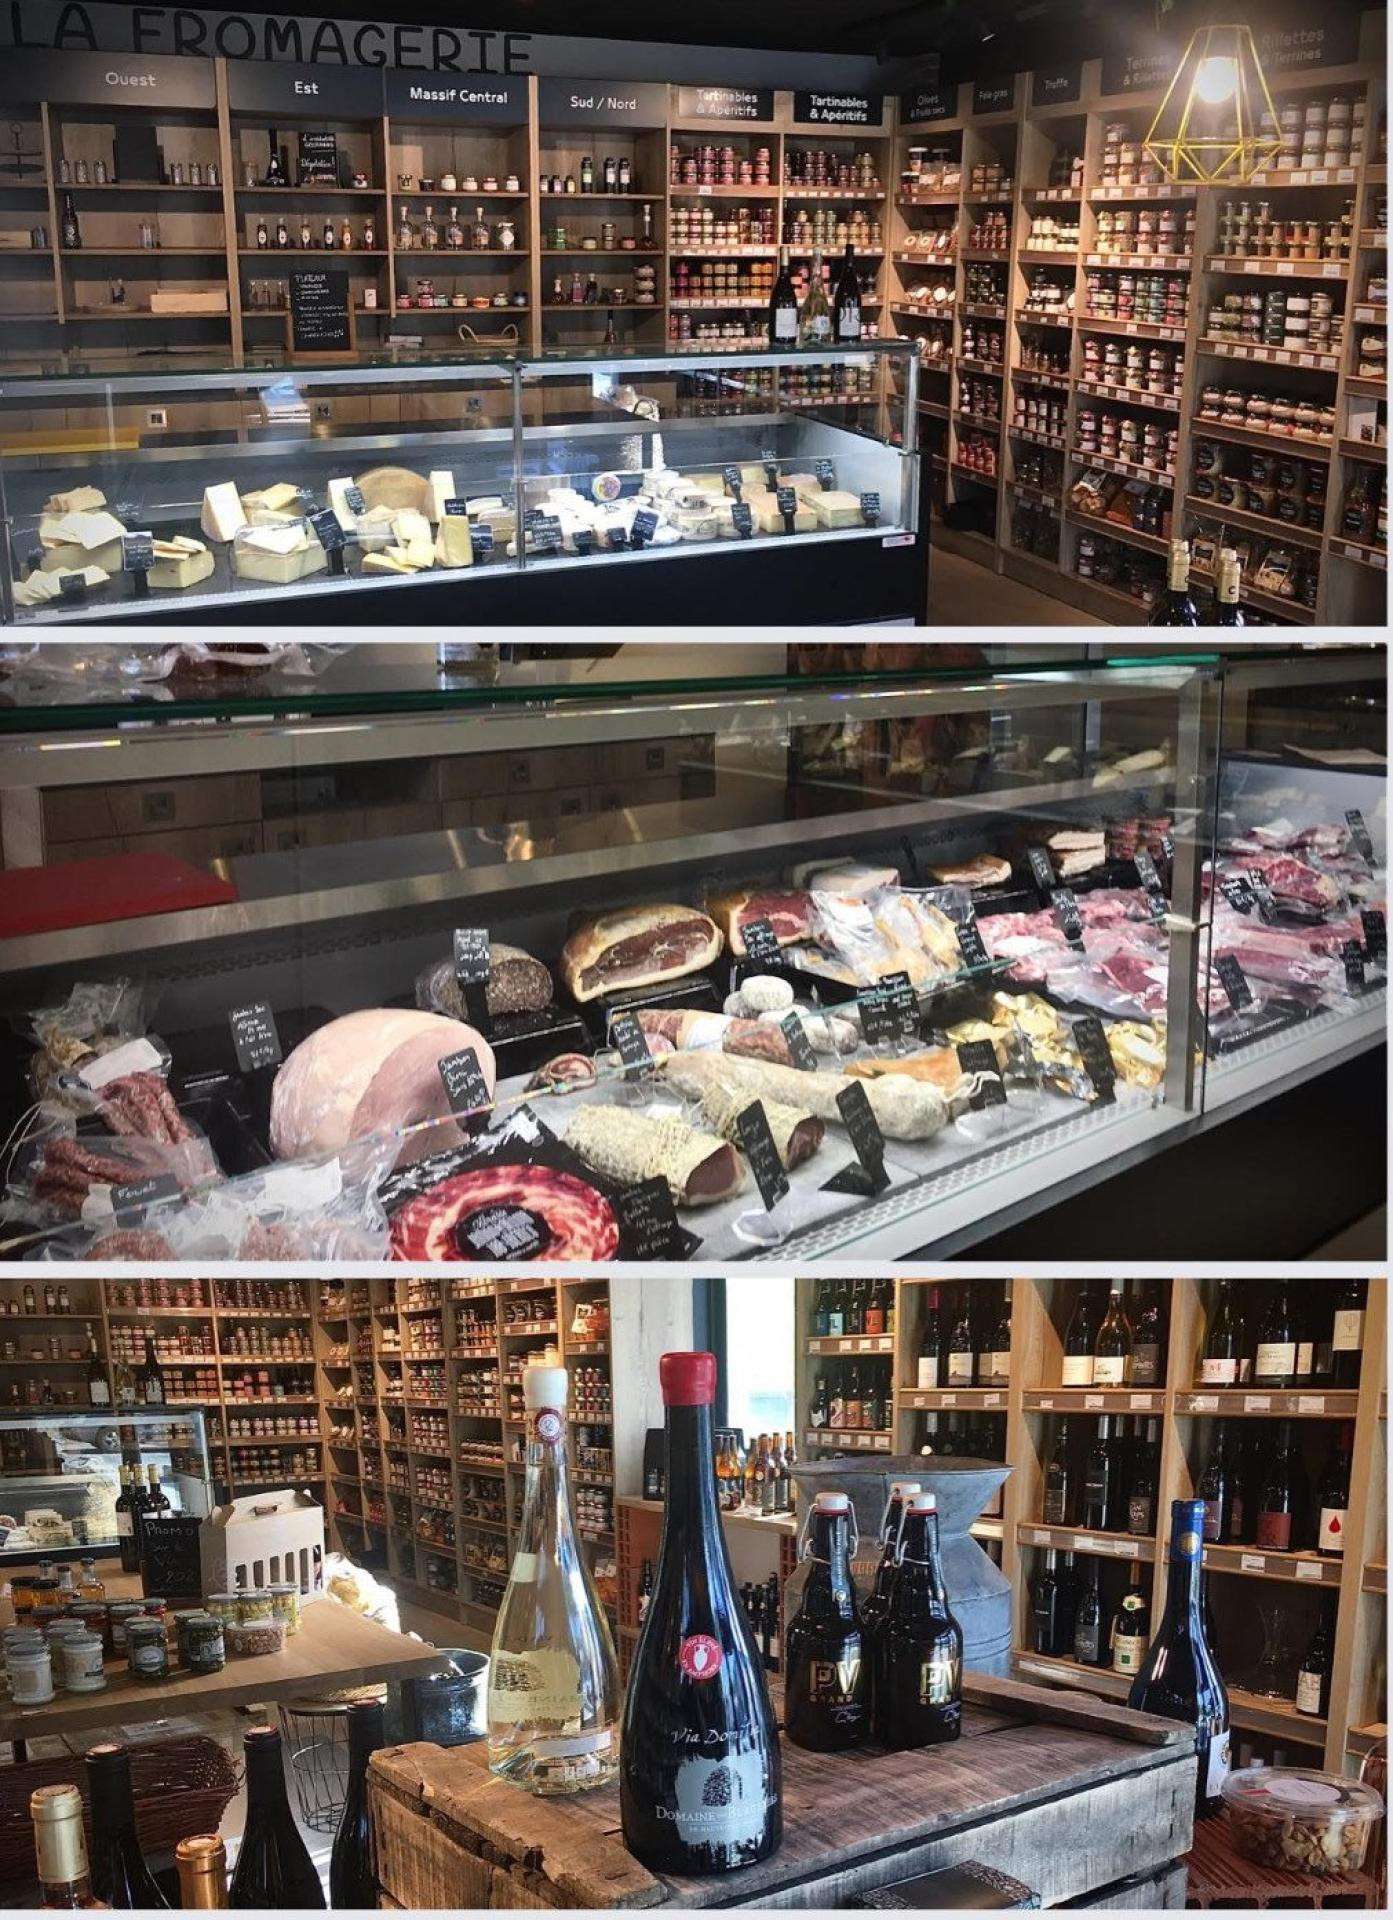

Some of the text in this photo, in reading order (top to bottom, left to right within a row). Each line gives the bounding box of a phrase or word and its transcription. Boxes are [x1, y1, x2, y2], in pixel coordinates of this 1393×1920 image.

[10, 1, 533, 73] LA FROMAGERIE
[106, 72, 156, 87] Ouest
[294, 81, 319, 95] Est
[409, 87, 508, 104] Massif Central
[696, 89, 758, 103] Tartinables
[809, 95, 868, 109] Tartinables
[570, 96, 593, 109] Sud
[607, 97, 637, 110] Nord
[671, 1727, 700, 1744] Via
